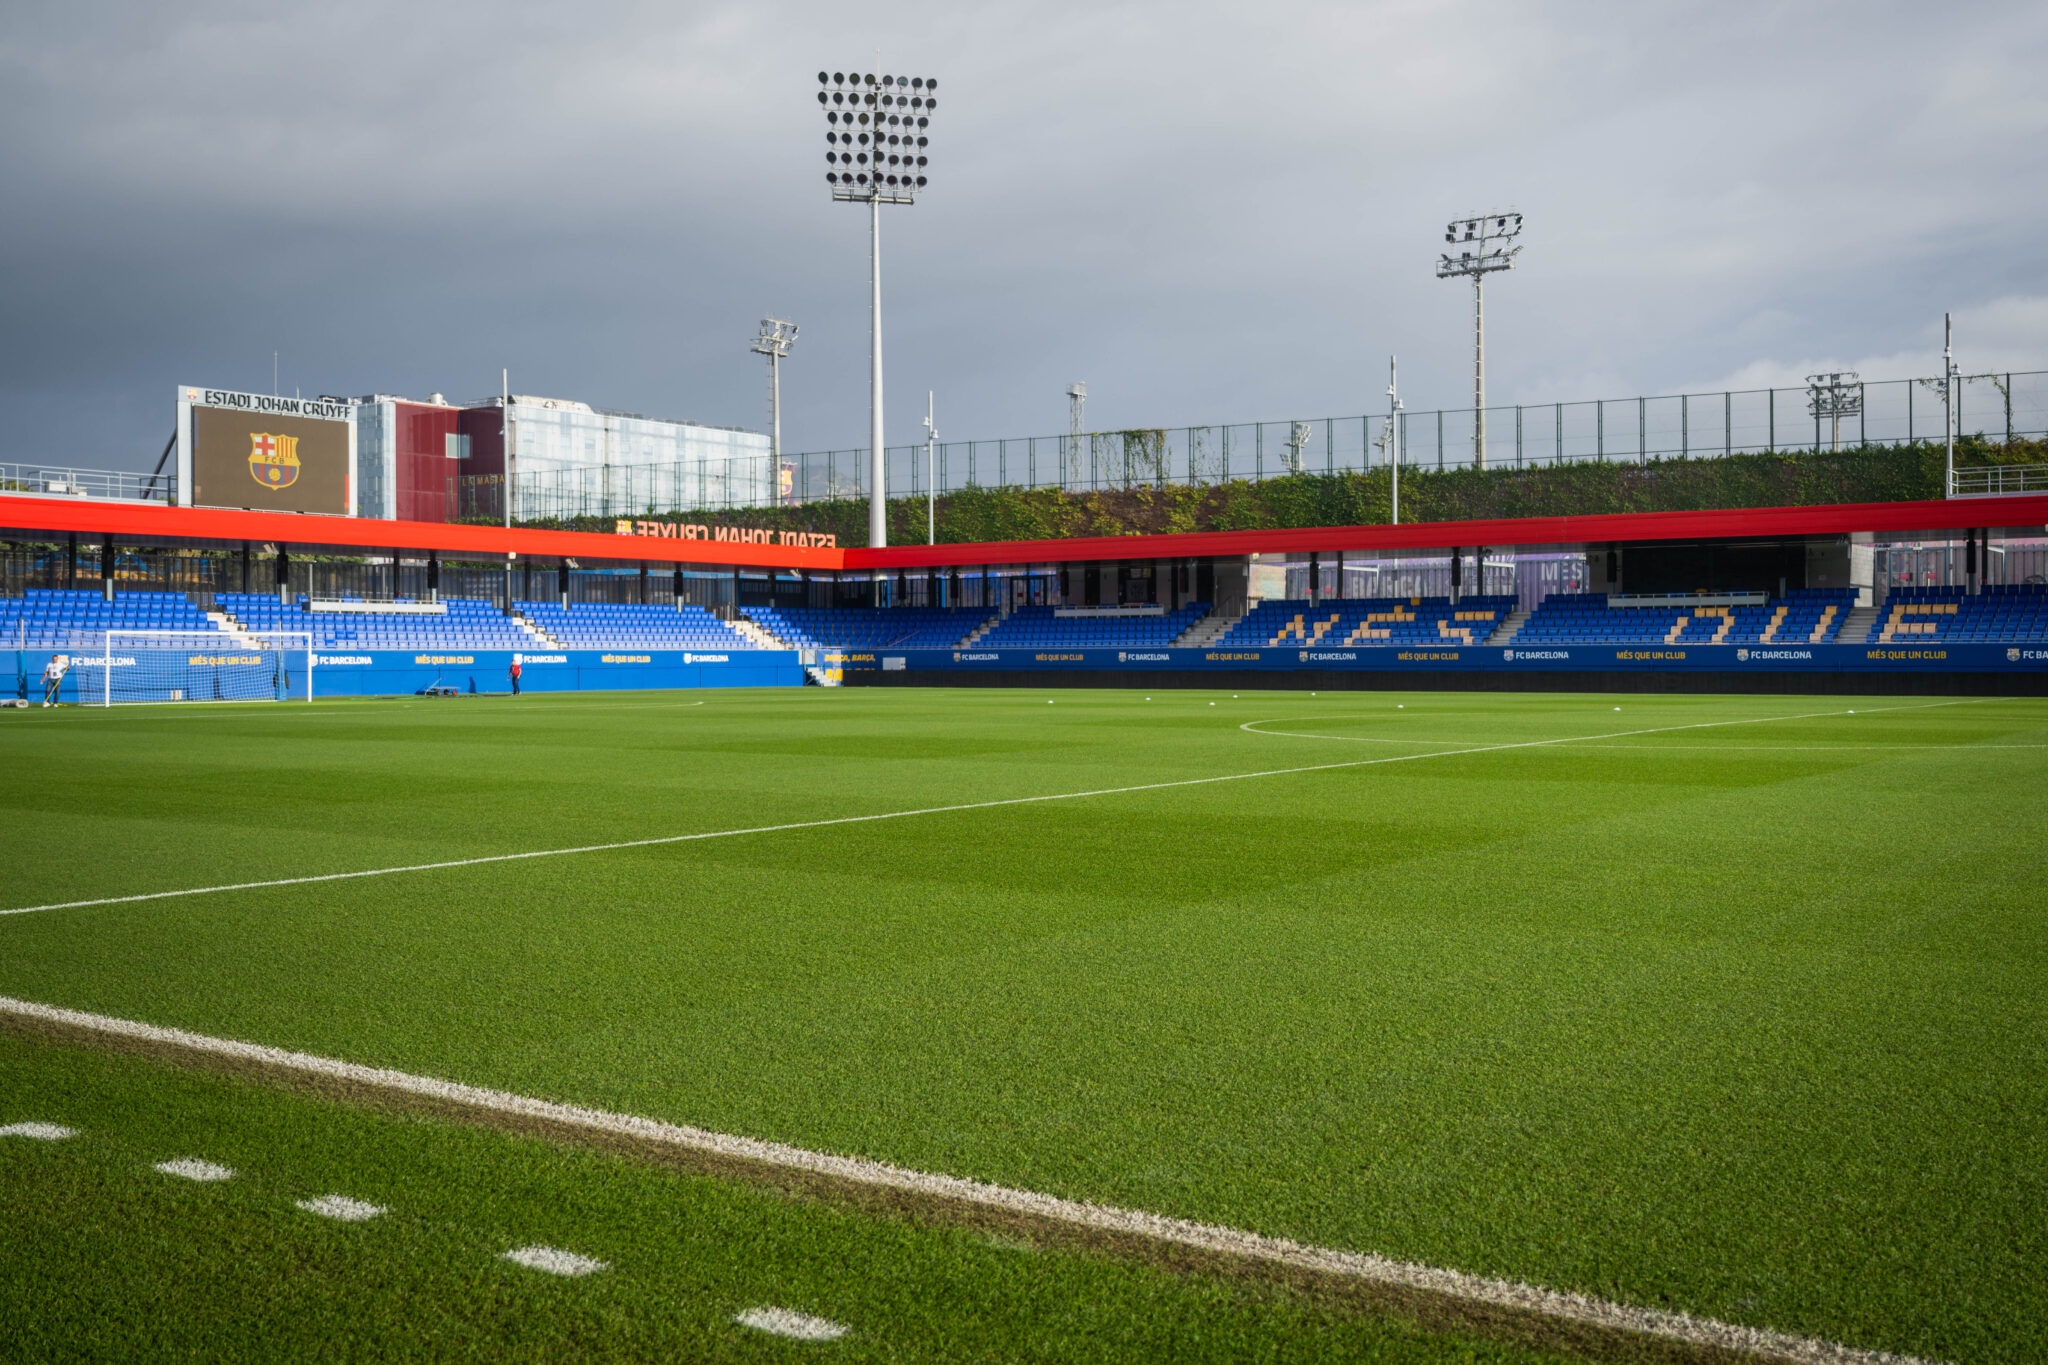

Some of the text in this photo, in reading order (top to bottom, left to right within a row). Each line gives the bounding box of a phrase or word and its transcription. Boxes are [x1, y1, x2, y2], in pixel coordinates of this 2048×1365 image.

[205, 390, 352, 418] ESTADI JOHAN CRUYFF
[415, 653, 474, 665] MÉS QUE UN CLUB
[1318, 653, 1357, 661] BARCELONA
[1398, 651, 1459, 661] MÉS QUE UN CLUB
[1515, 651, 1569, 659] FC BARCELONA
[1616, 650, 1634, 659] MÉS
[1634, 652, 1651, 661] QUE
[1664, 651, 1686, 659] CLUB
[1751, 651, 1812, 659] FC BARCELONA
[1867, 649, 1947, 661] MÉS QUE UN CLUB
[2023, 651, 2035, 660] FC
[71, 657, 83, 666] FC
[329, 656, 372, 665] BARCELONA
